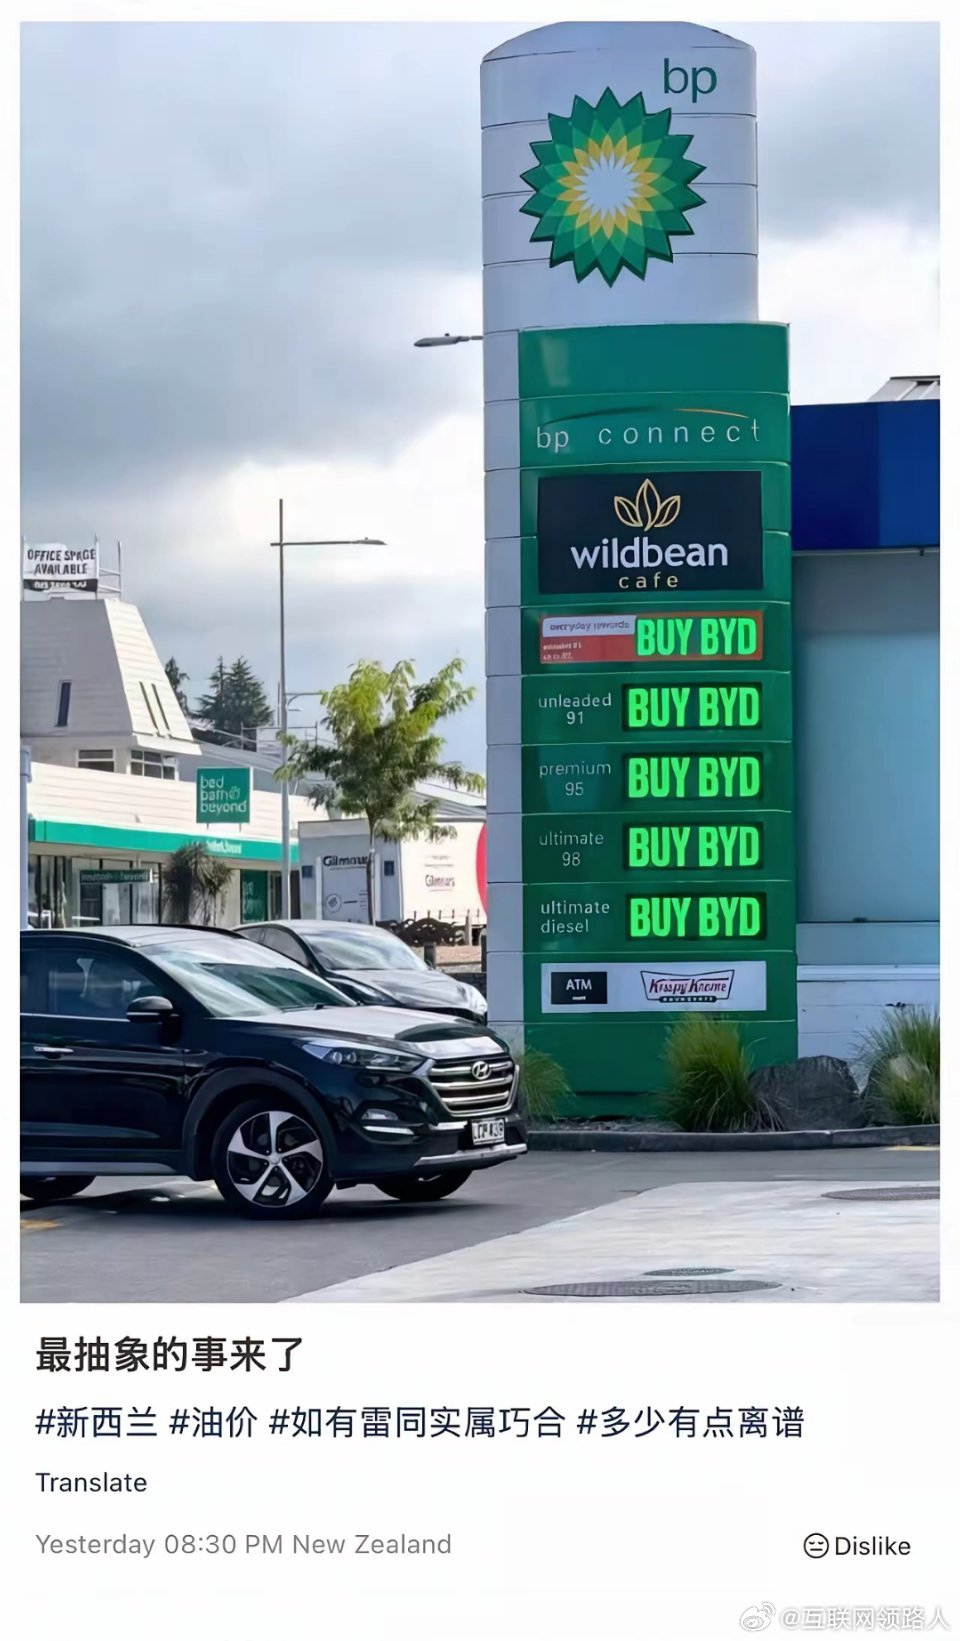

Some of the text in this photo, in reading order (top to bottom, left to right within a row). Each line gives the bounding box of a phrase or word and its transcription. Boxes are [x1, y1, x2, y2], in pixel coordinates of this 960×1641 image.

[664, 57, 717, 103] bp
[537, 419, 760, 453] bp connect
[27, 549, 62, 561] OFFICE
[570, 537, 728, 569] wildbean
[34, 563, 88, 576] AVAILABLE
[618, 572, 678, 589] cafe
[637, 617, 757, 656] BUY BYD
[538, 693, 612, 708] unleaded
[628, 687, 759, 727] BUY BYD
[566, 712, 584, 725] 91
[539, 762, 612, 778] premium
[628, 757, 760, 798] BUY BYD
[200, 775, 224, 789] bed
[565, 783, 584, 796] 95
[200, 800, 248, 817] beyond
[539, 832, 604, 846] ultimate
[629, 826, 759, 867] BUY BYD
[562, 853, 581, 866] 98
[540, 900, 610, 914] ultimate
[630, 897, 761, 937] BUY BYD
[541, 920, 589, 933] diesel
[566, 979, 592, 990] ATM
